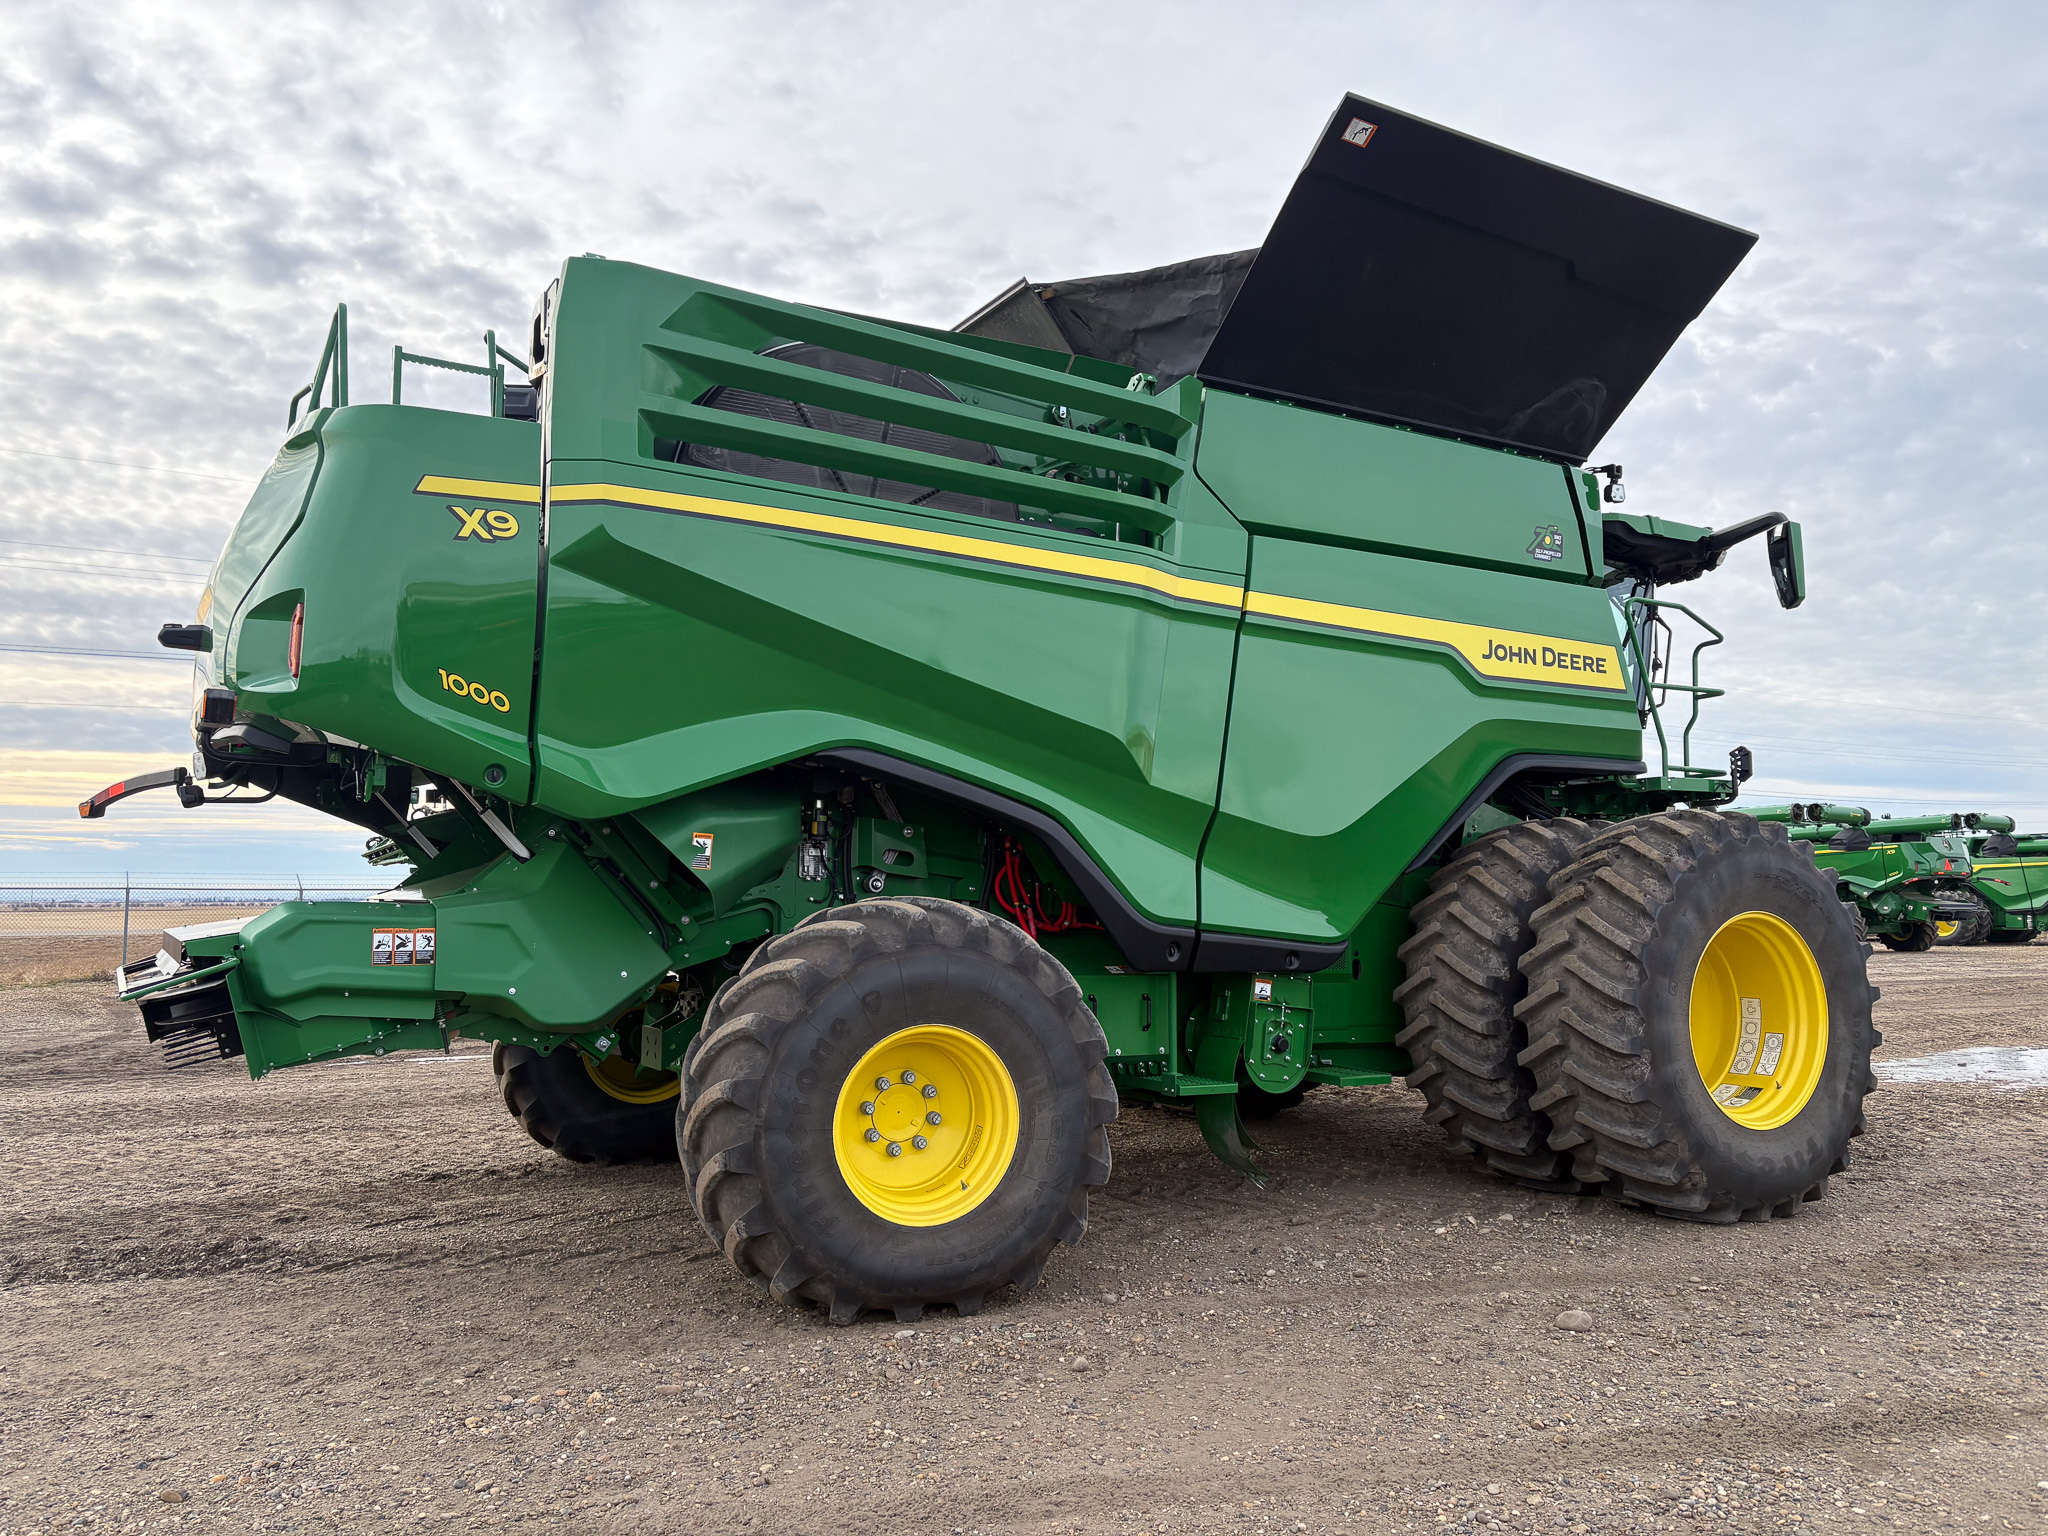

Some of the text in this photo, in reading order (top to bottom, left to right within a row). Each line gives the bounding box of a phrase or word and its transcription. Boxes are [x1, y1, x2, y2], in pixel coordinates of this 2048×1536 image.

[446, 505, 519, 543] X9
[1482, 639, 1607, 674] JOHN DEERE
[437, 667, 511, 714] 1000
